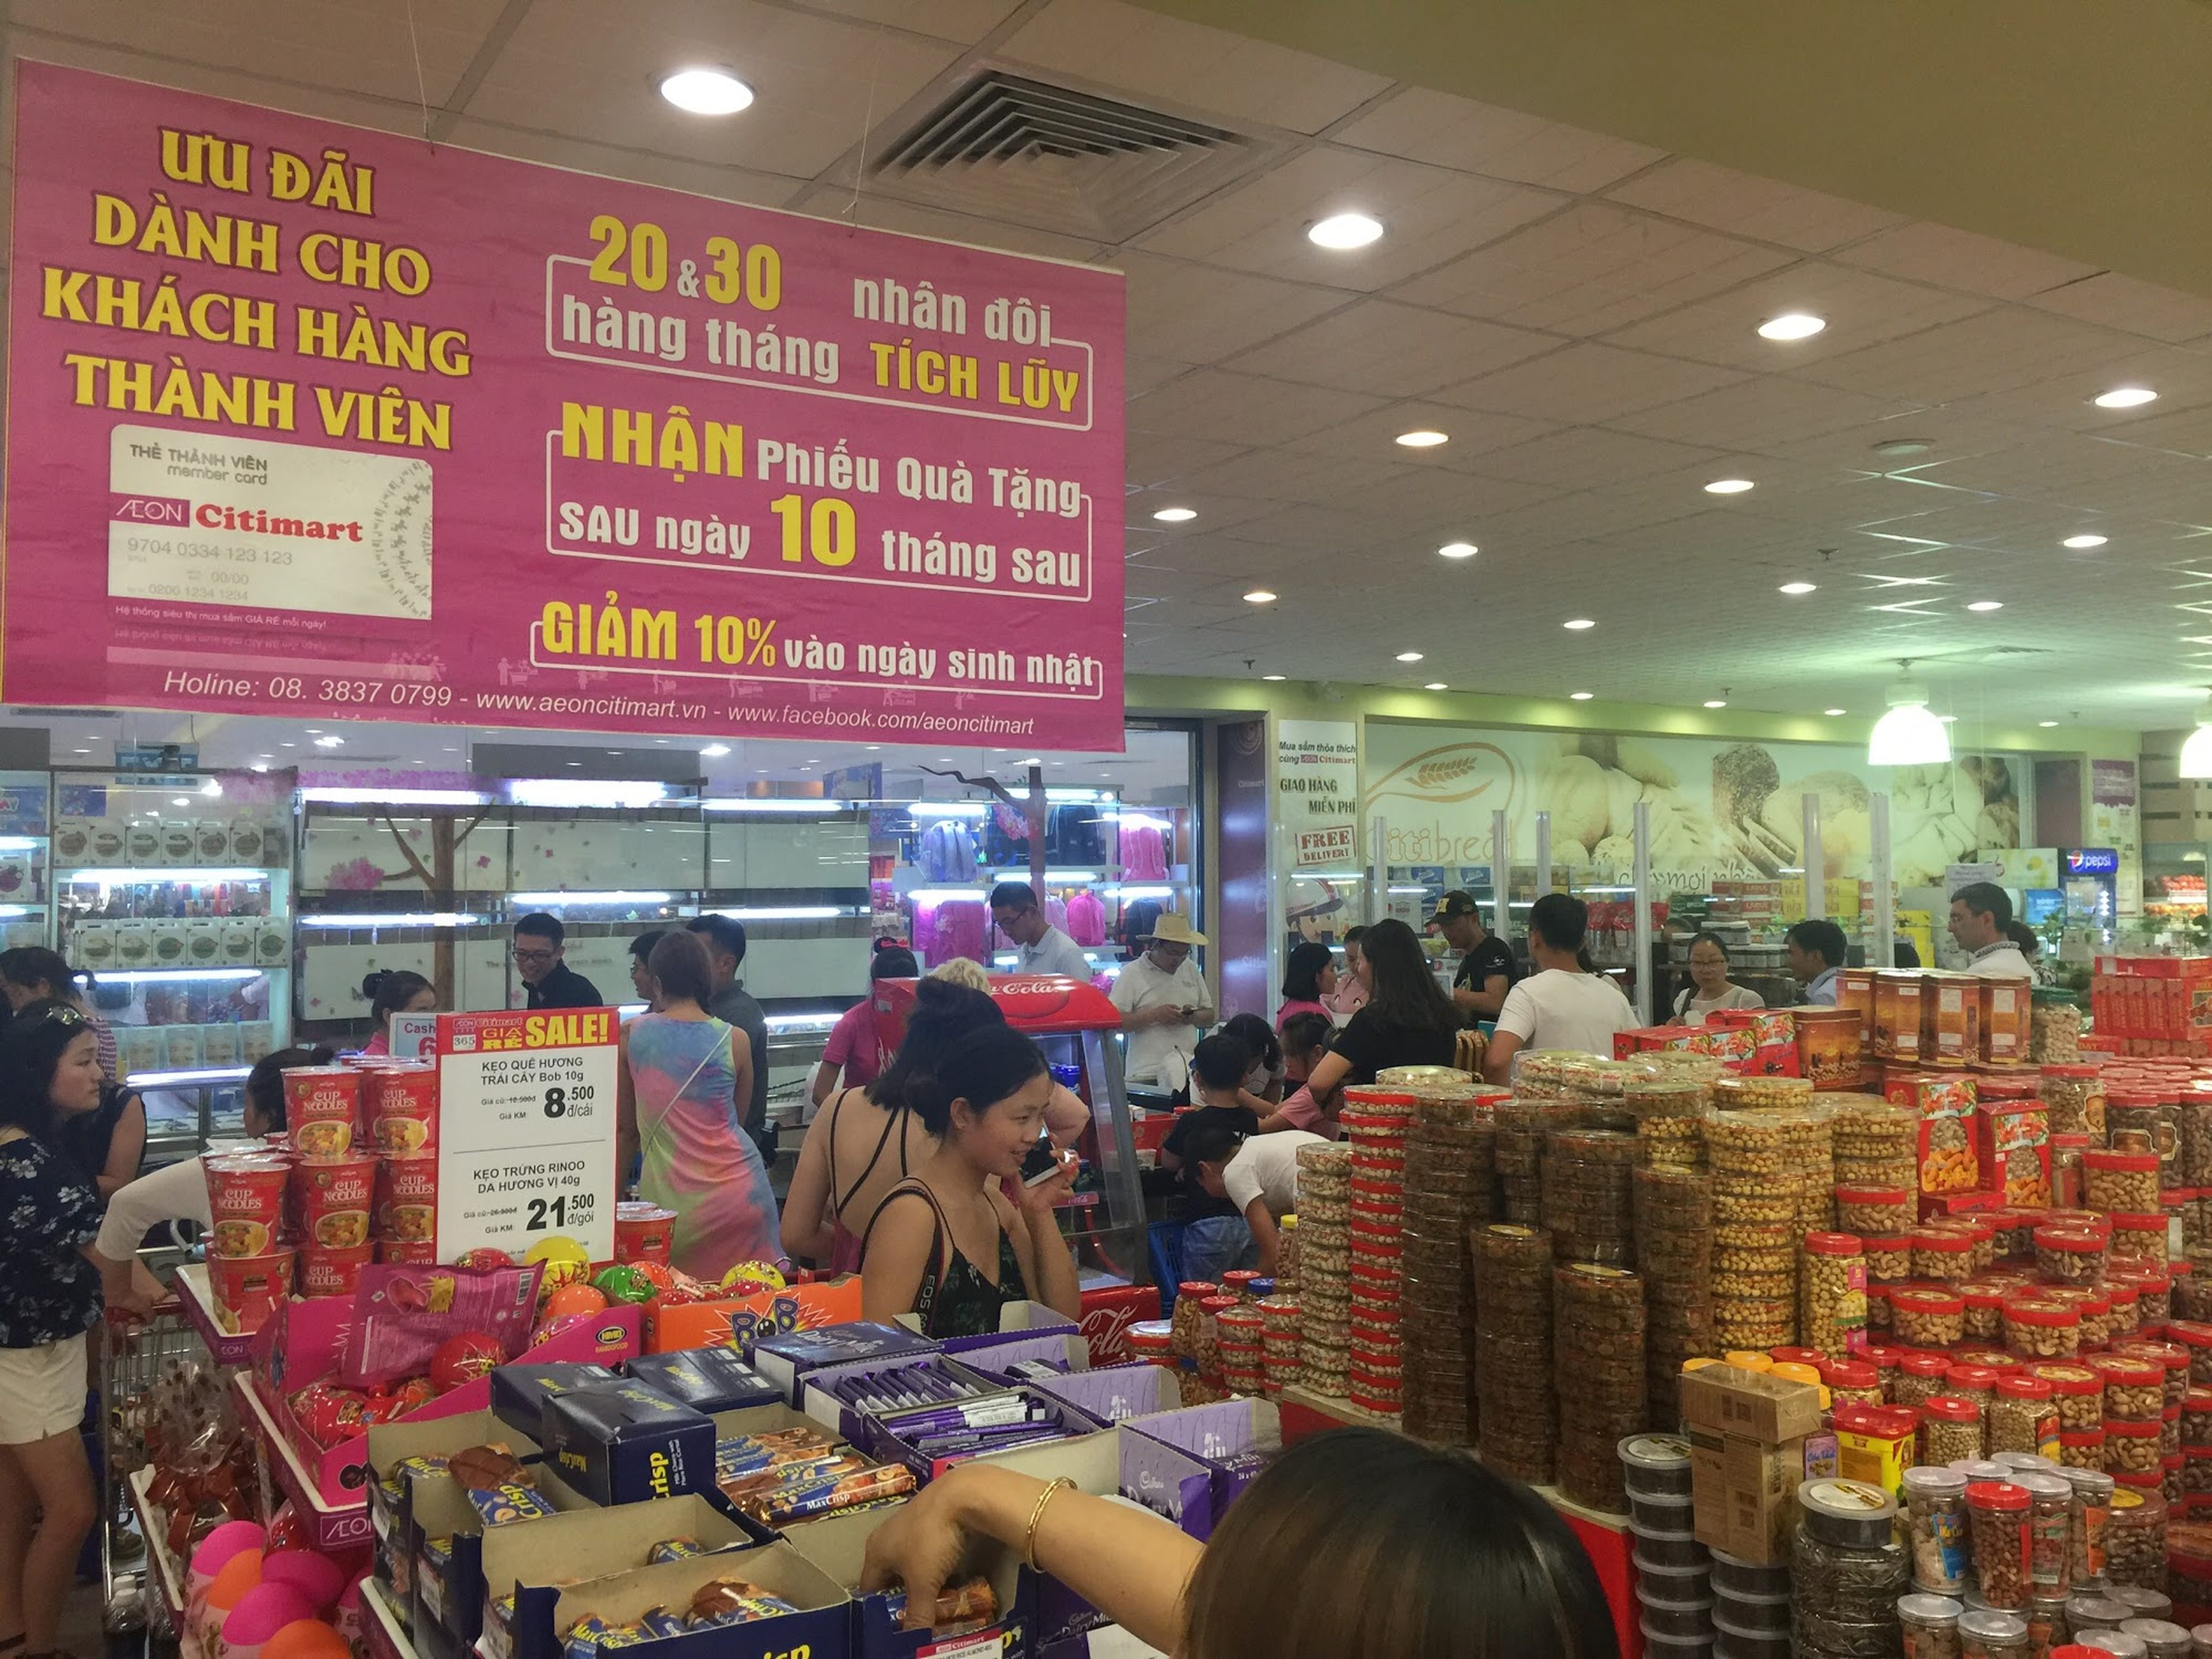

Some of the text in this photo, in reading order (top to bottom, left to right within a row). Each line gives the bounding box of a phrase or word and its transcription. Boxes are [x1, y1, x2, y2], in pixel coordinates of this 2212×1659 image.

[161, 129, 373, 215] ƯU ĐÃI
[94, 193, 431, 296] DÀNH CHO
[589, 215, 782, 311] 20 & 30
[43, 267, 471, 376] KHÁCH HÀNG
[853, 278, 1050, 348] nhân đôi
[562, 294, 839, 384] hàng tháng
[870, 338, 1079, 412] TÍCH LŨY
[65, 355, 451, 450] THÀNH VIÊN
[232, 454, 268, 471] VIÊN
[562, 402, 1081, 520] NHẬN Phiếu Quà Tặng
[167, 465, 267, 484] member card
[196, 503, 363, 542] Citimart
[559, 495, 1081, 588] SAU ngày 10 tháng sau
[128, 538, 292, 565] 9704 0334 123 123
[541, 590, 1094, 691] GIẢM 10% vào ngày sinh nhật
[164, 671, 259, 698] Holine:
[320, 679, 380, 703] 3837
[391, 683, 452, 707] 0799
[476, 691, 707, 720] www.aeoncitimart.vn
[728, 704, 1035, 734] www.facebook.com/aeoncitimart
[1279, 741, 1296, 751] Mua
[1319, 755, 1356, 764] Citimart
[1280, 776, 1338, 792] GIAO HÀNG
[1301, 830, 1350, 850] FREE
[1304, 848, 1350, 861] DELIVERY
[2084, 854, 2112, 869] pepsi
[404, 1022, 436, 1034] Cash
[476, 1017, 523, 1027] Citimart
[525, 1013, 609, 1047] SALE!
[453, 1036, 476, 1046] 365
[482, 1056, 584, 1073] KẸO QUÊ HƯƠNG
[481, 1070, 584, 1086] TRÁI CÂY Bob 10g
[313, 1091, 340, 1102] CUP
[383, 1089, 407, 1099] CUP
[304, 1100, 348, 1111] NOODLES
[567, 1103, 593, 1118] đ/cái
[474, 1160, 585, 1181] KẸO TRỨNG RINOO
[334, 1180, 362, 1191] CUP
[399, 1176, 426, 1186] CUP
[478, 1175, 581, 1194] DA HƯƠNG VỊ 40g
[225, 1189, 253, 1200] CUP
[324, 1189, 368, 1202] NOODLES
[217, 1198, 262, 1210] NOODLES
[567, 1211, 594, 1227] đ/gói
[485, 1226, 498, 1234] Giá
[309, 1266, 334, 1276] CUP
[919, 1274, 935, 1309] EOS
[806, 1493, 851, 1511] MaxCrisp
[952, 1636, 985, 1650] Citimart
